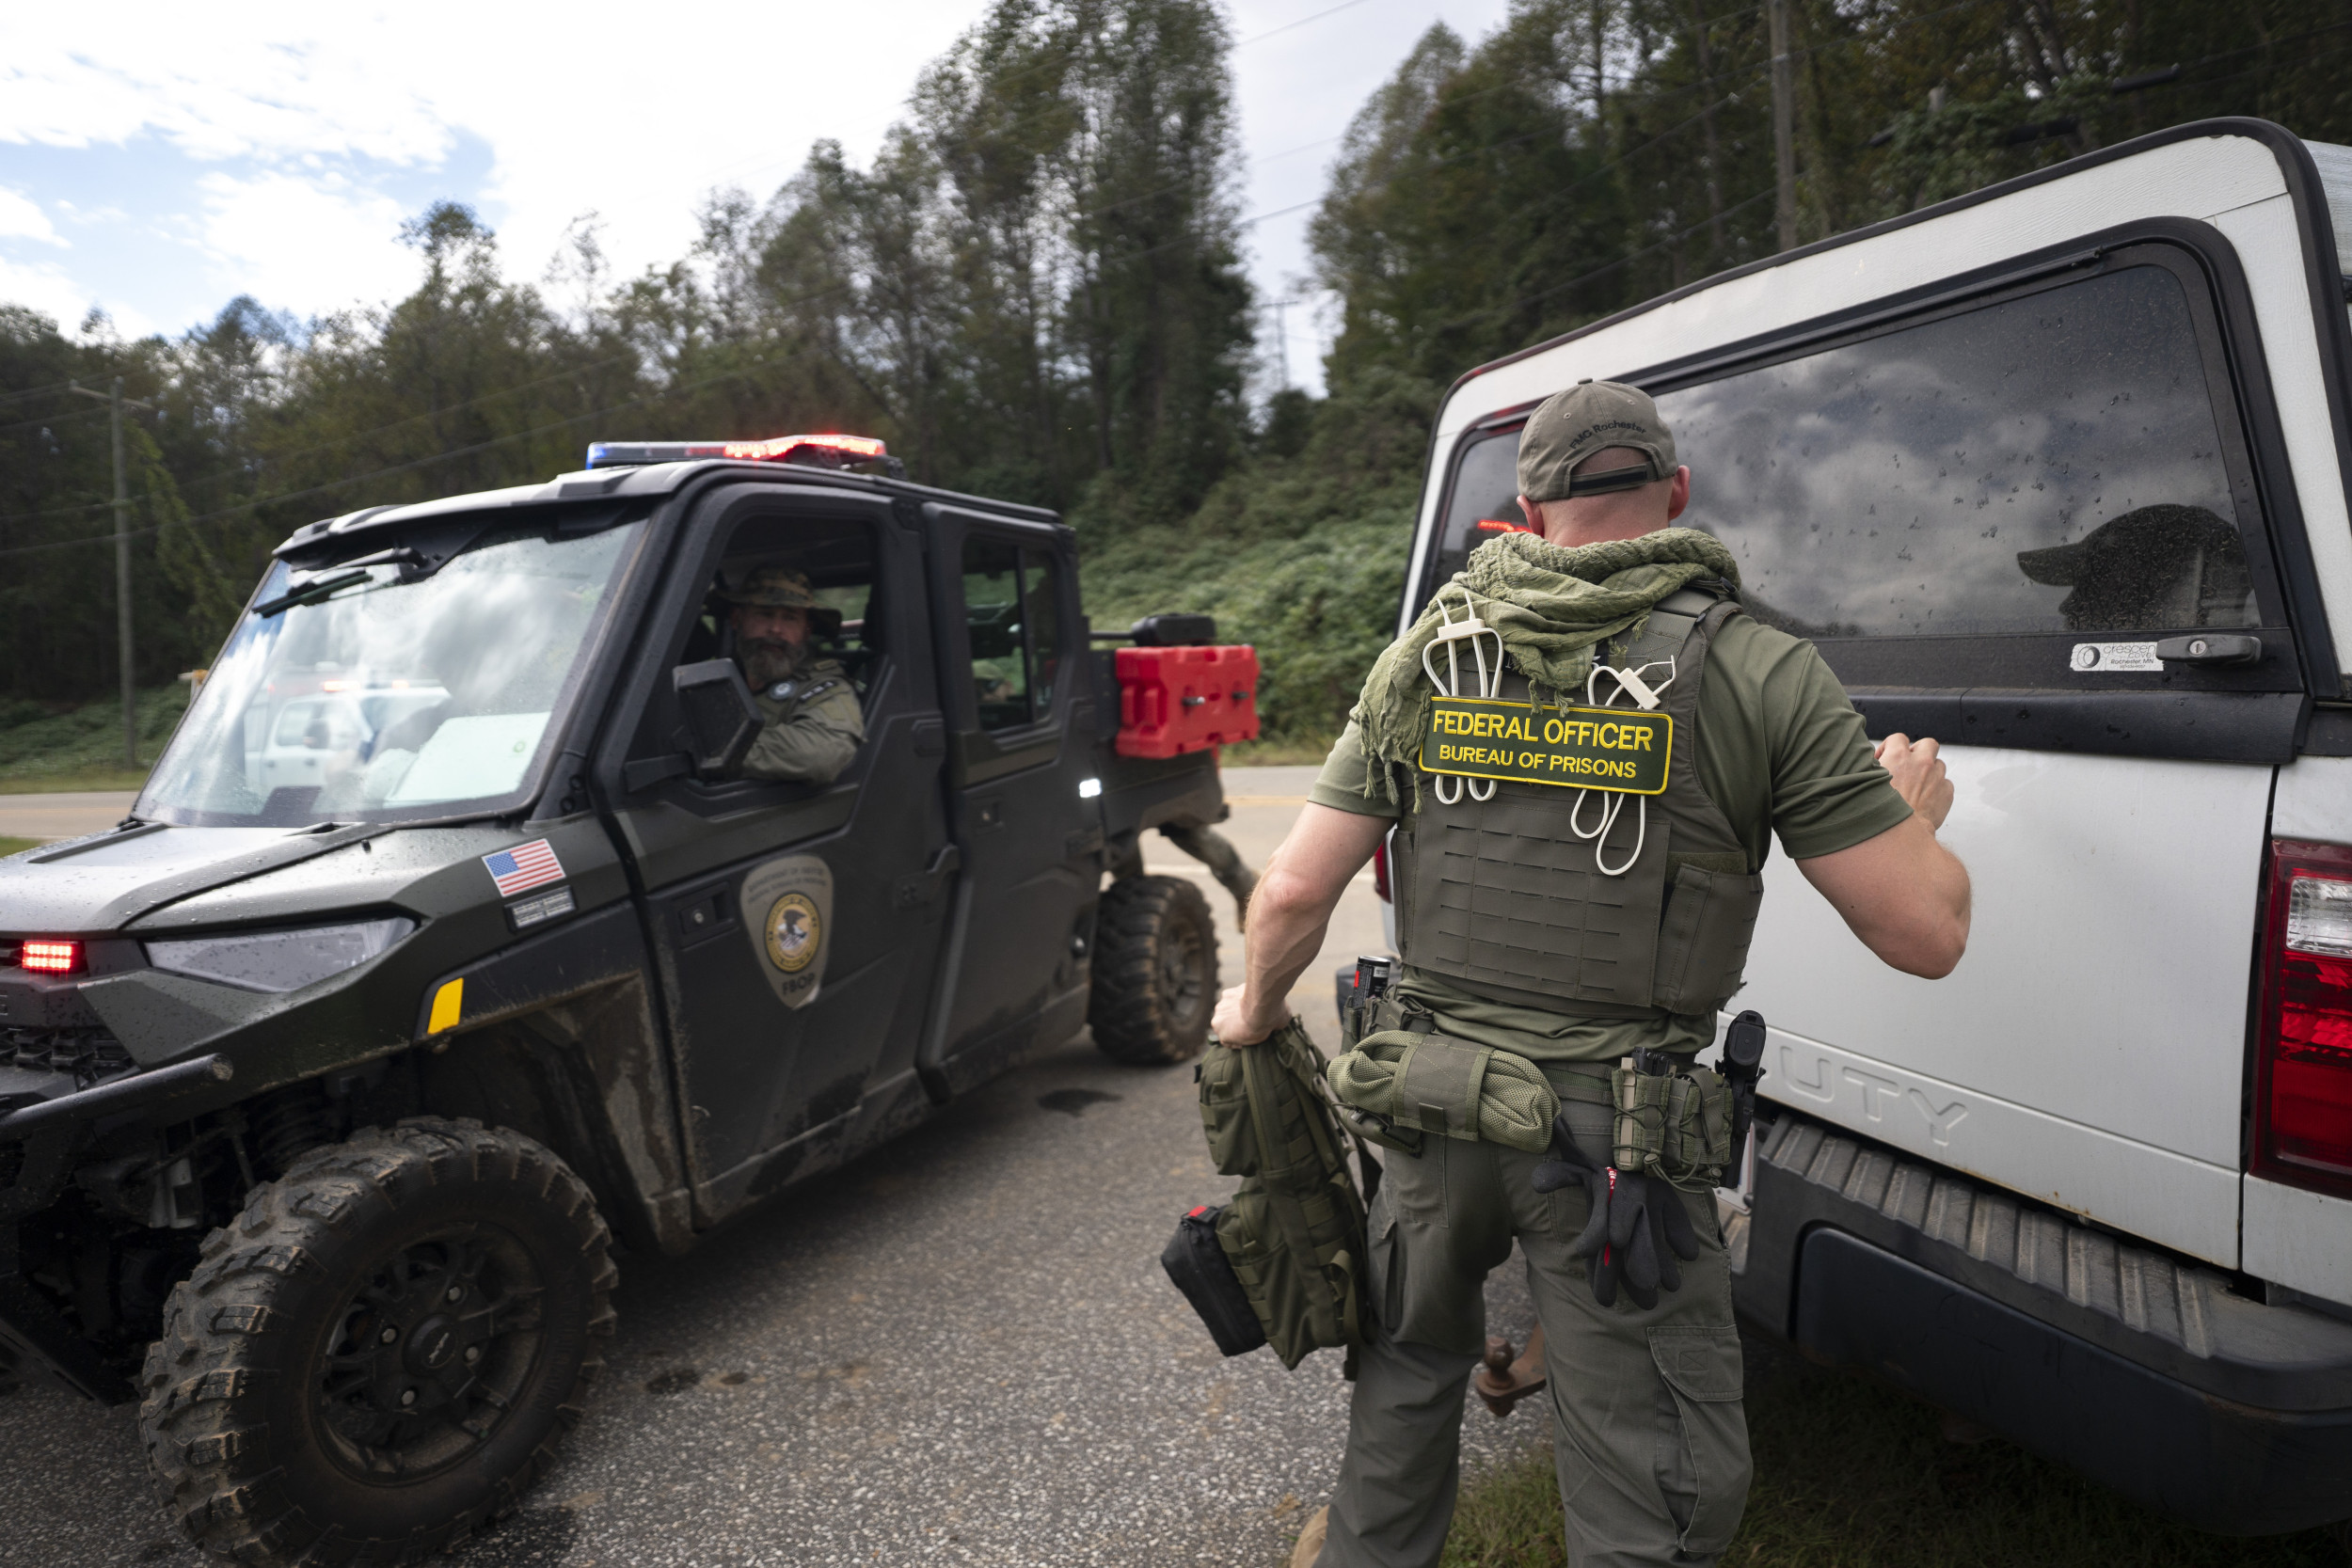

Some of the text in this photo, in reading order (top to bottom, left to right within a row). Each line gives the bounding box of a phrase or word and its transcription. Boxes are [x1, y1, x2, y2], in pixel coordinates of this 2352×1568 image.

[1592, 420, 1647, 435] Rochester
[2103, 644, 2156, 655] crescen
[1432, 708, 1655, 752] FEDERAL OFFICER
[1438, 744, 1638, 780] BUREAU OF PRISONS
[782, 973, 816, 996] FBOP
[1763, 1042, 1970, 1148] UTY
